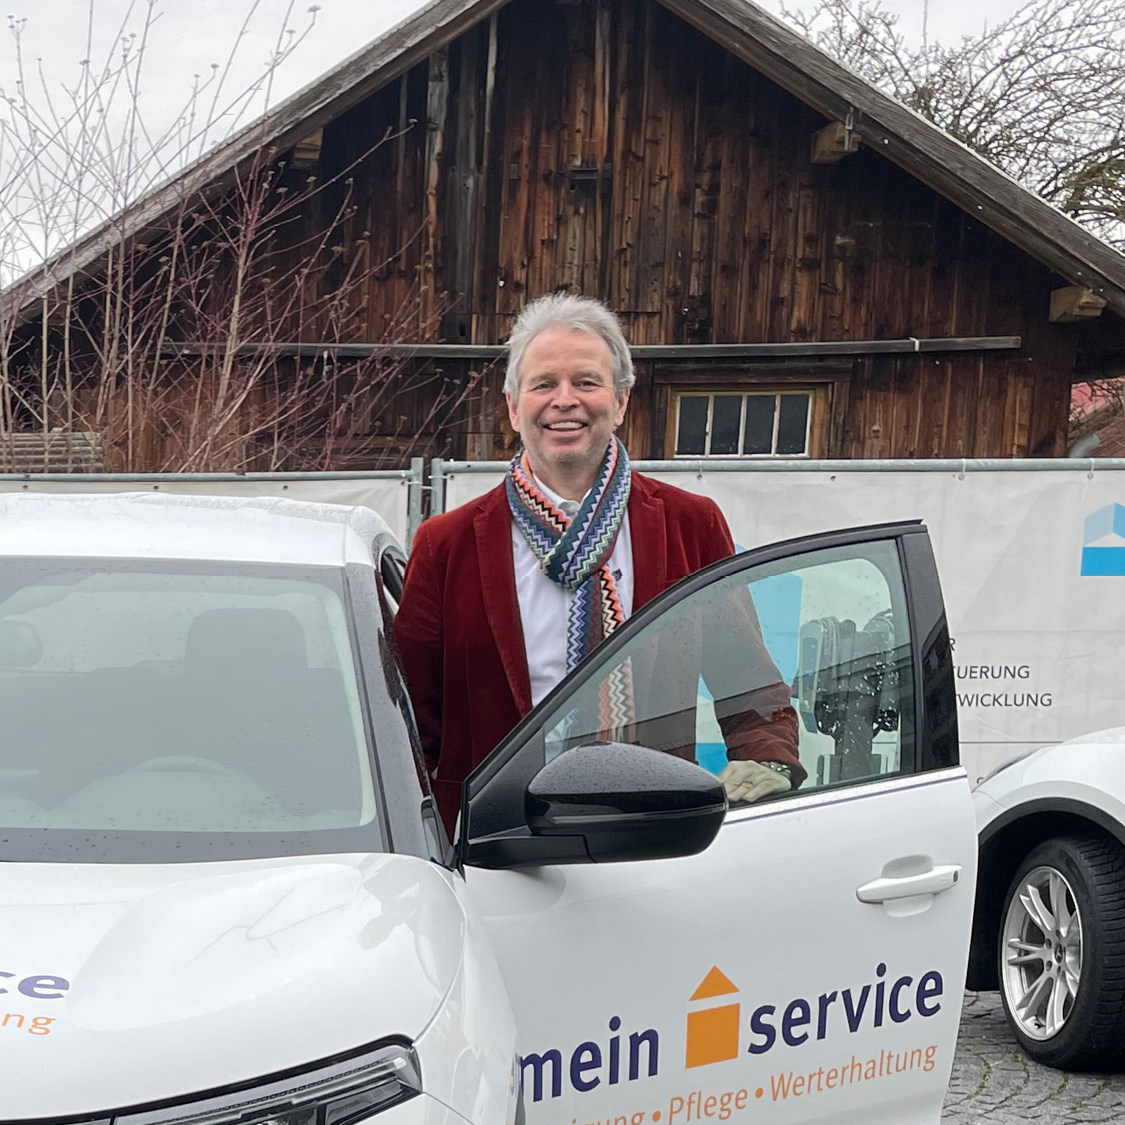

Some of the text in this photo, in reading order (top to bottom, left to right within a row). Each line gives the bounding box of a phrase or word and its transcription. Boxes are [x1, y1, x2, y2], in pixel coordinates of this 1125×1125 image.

[954, 665, 1031, 680] UERUNG
[957, 692, 1054, 708] WICKLUNG
[519, 962, 944, 1103] mein service
[668, 1088, 749, 1125] Pflege
[770, 1044, 939, 1102] Werterhaltung
